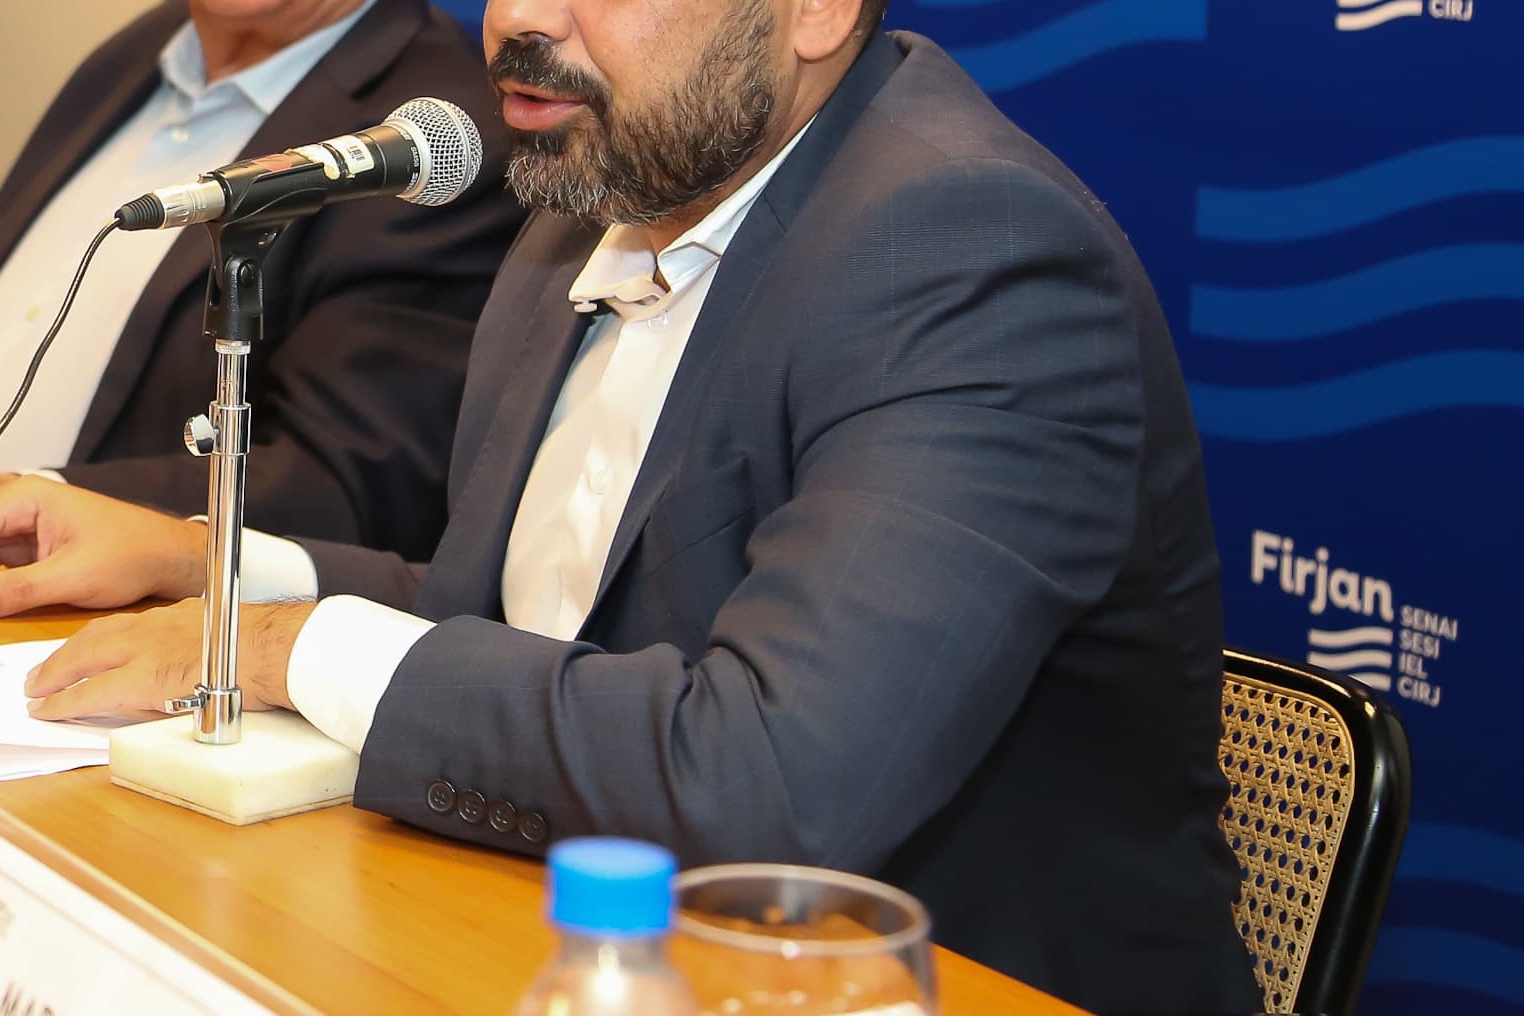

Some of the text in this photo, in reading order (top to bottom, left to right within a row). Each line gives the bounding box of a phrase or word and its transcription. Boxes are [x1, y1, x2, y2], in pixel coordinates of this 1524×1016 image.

[1250, 529, 1395, 623] Firjan
[1400, 604, 1459, 641] SENAI
[1399, 629, 1440, 660] SESI
[1398, 651, 1428, 679] IEL
[1397, 676, 1441, 708] CIRJ
